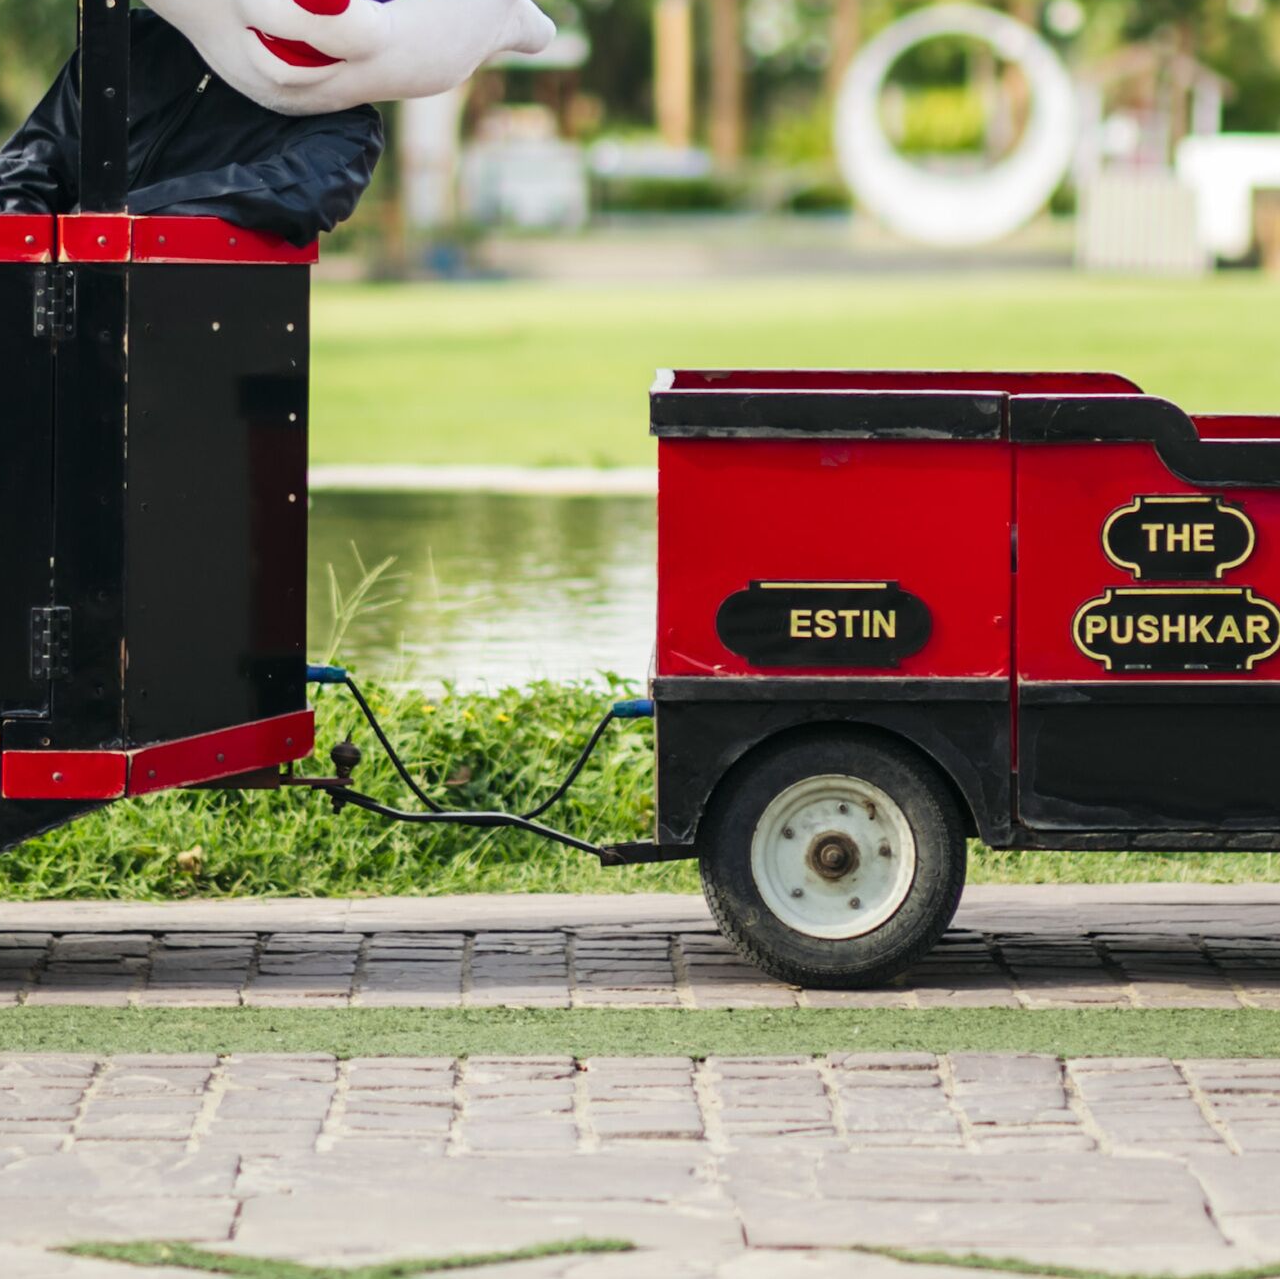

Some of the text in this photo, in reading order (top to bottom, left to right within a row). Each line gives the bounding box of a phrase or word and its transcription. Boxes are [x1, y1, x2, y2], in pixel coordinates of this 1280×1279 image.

[1141, 523, 1215, 552] THE
[790, 609, 896, 638] ESTIN
[1085, 615, 1272, 644] PUSHKAR
